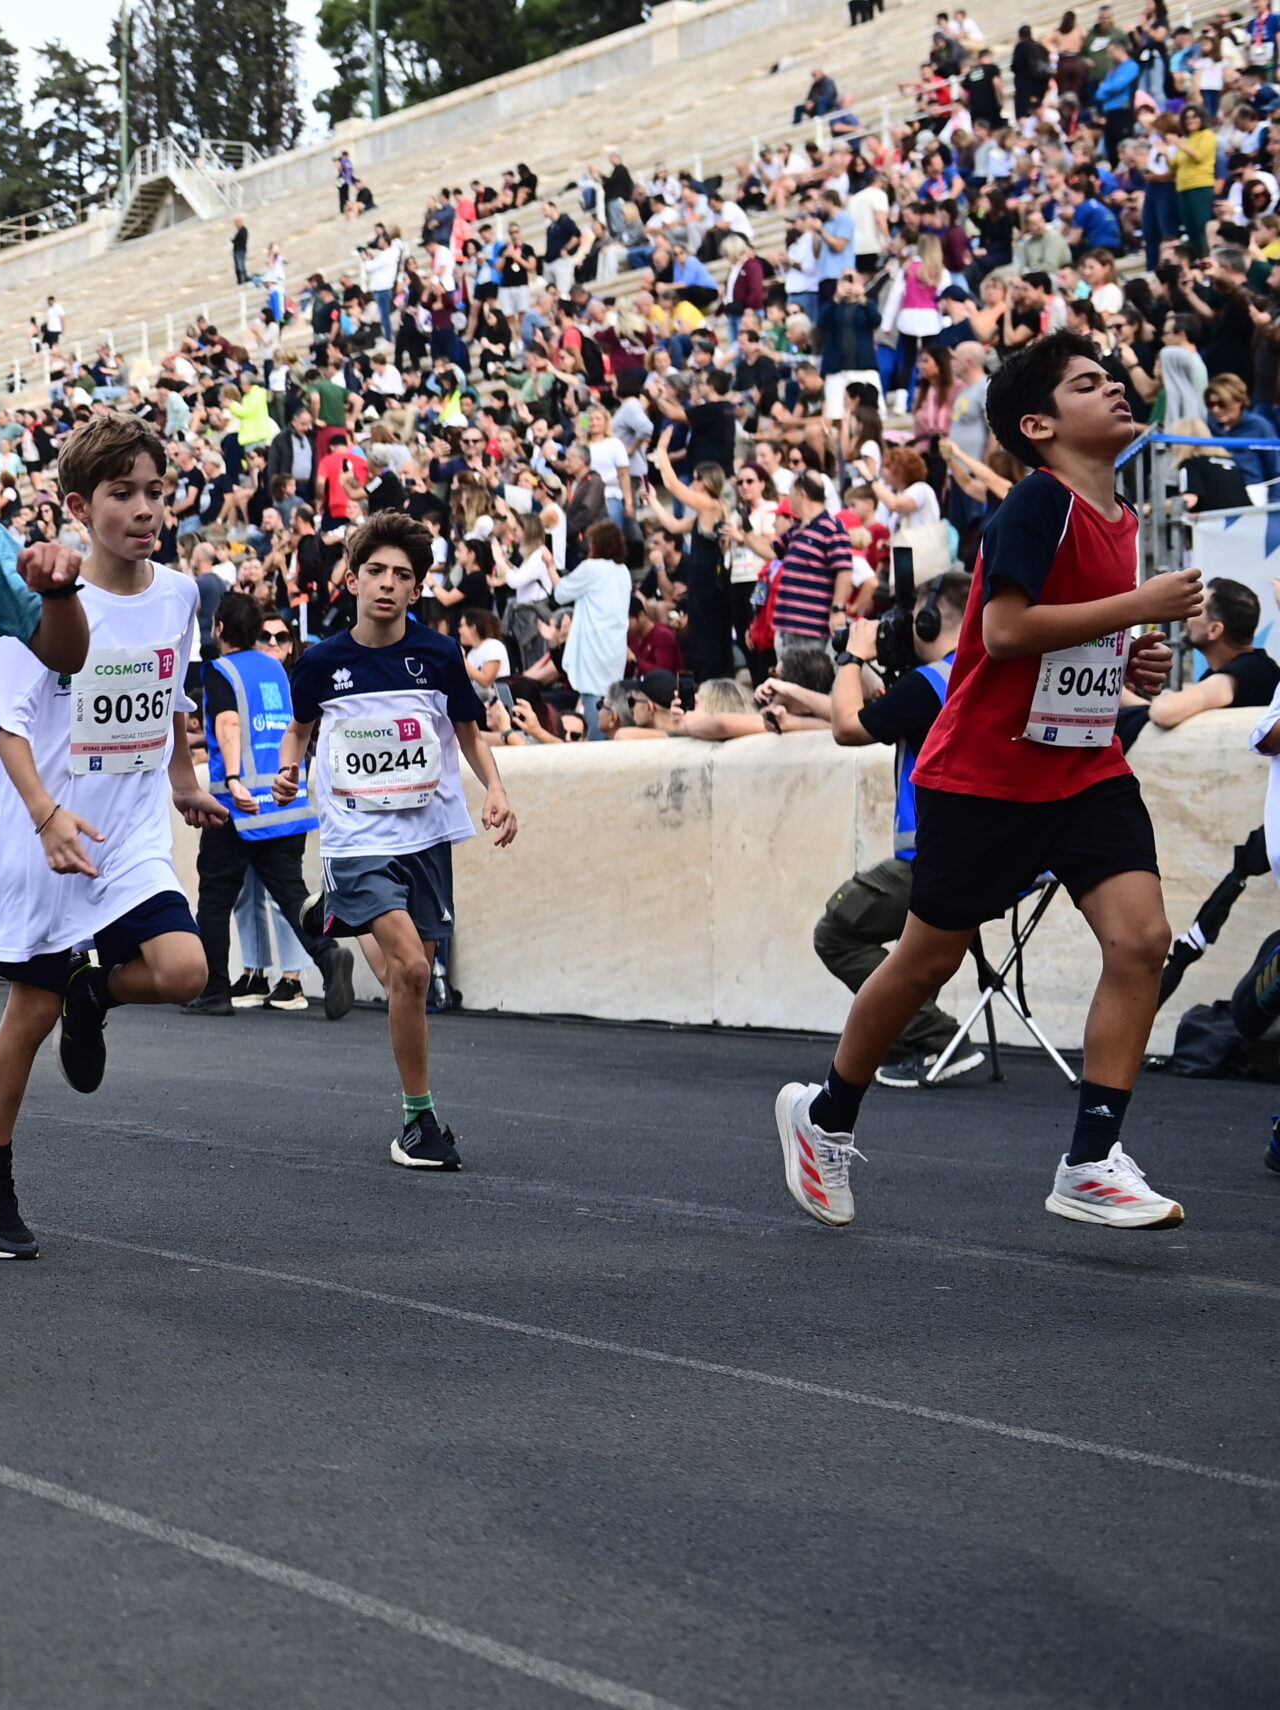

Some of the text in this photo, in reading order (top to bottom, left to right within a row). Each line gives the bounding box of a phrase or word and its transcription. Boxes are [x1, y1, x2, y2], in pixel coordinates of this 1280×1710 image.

[95, 662, 154, 676] COSMOTE
[1042, 666, 1052, 692] BLOCK
[1058, 666, 1122, 697] 90433
[93, 687, 172, 724] 90367
[345, 728, 393, 739] COSMOTE
[346, 746, 427, 774] 90244
